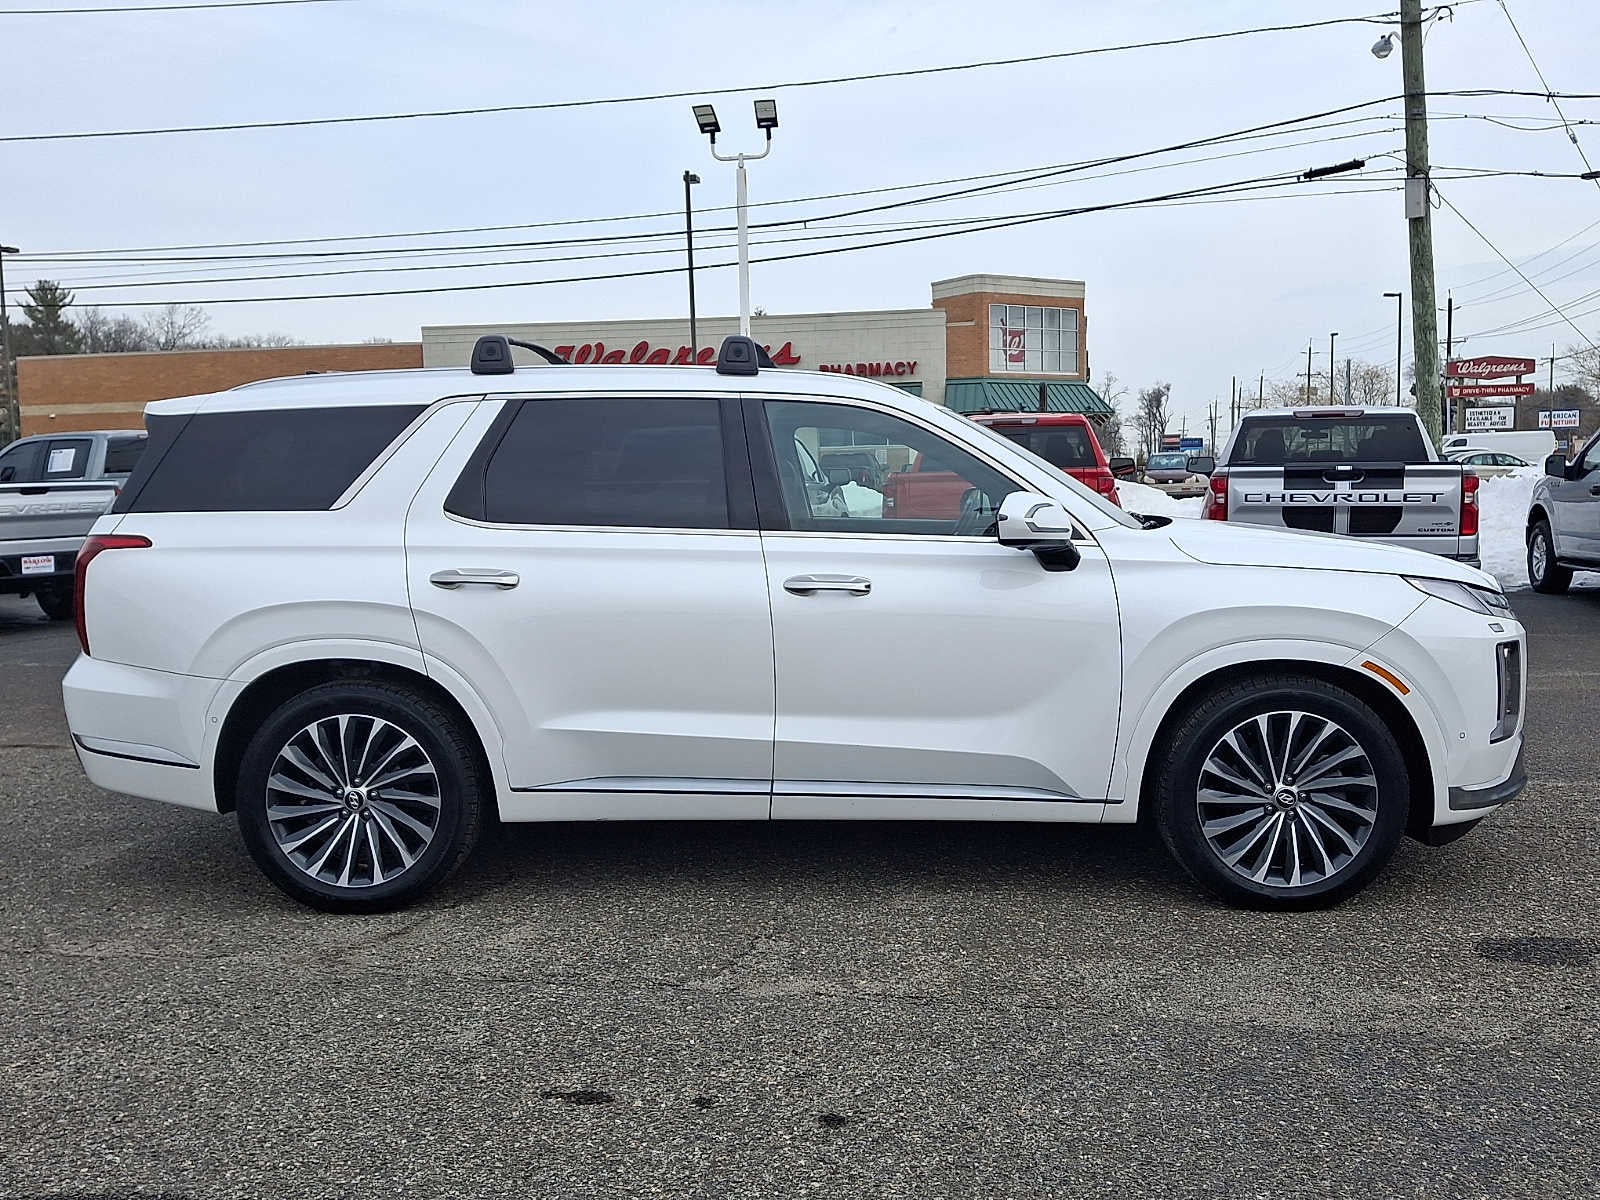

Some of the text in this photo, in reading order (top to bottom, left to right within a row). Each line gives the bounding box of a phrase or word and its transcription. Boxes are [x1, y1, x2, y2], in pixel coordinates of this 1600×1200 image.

[554, 338, 801, 366] Walgres
[819, 361, 918, 377] PHARMACY
[1456, 361, 1527, 377] Walgreens
[1244, 492, 1446, 503] CHEVROLET
